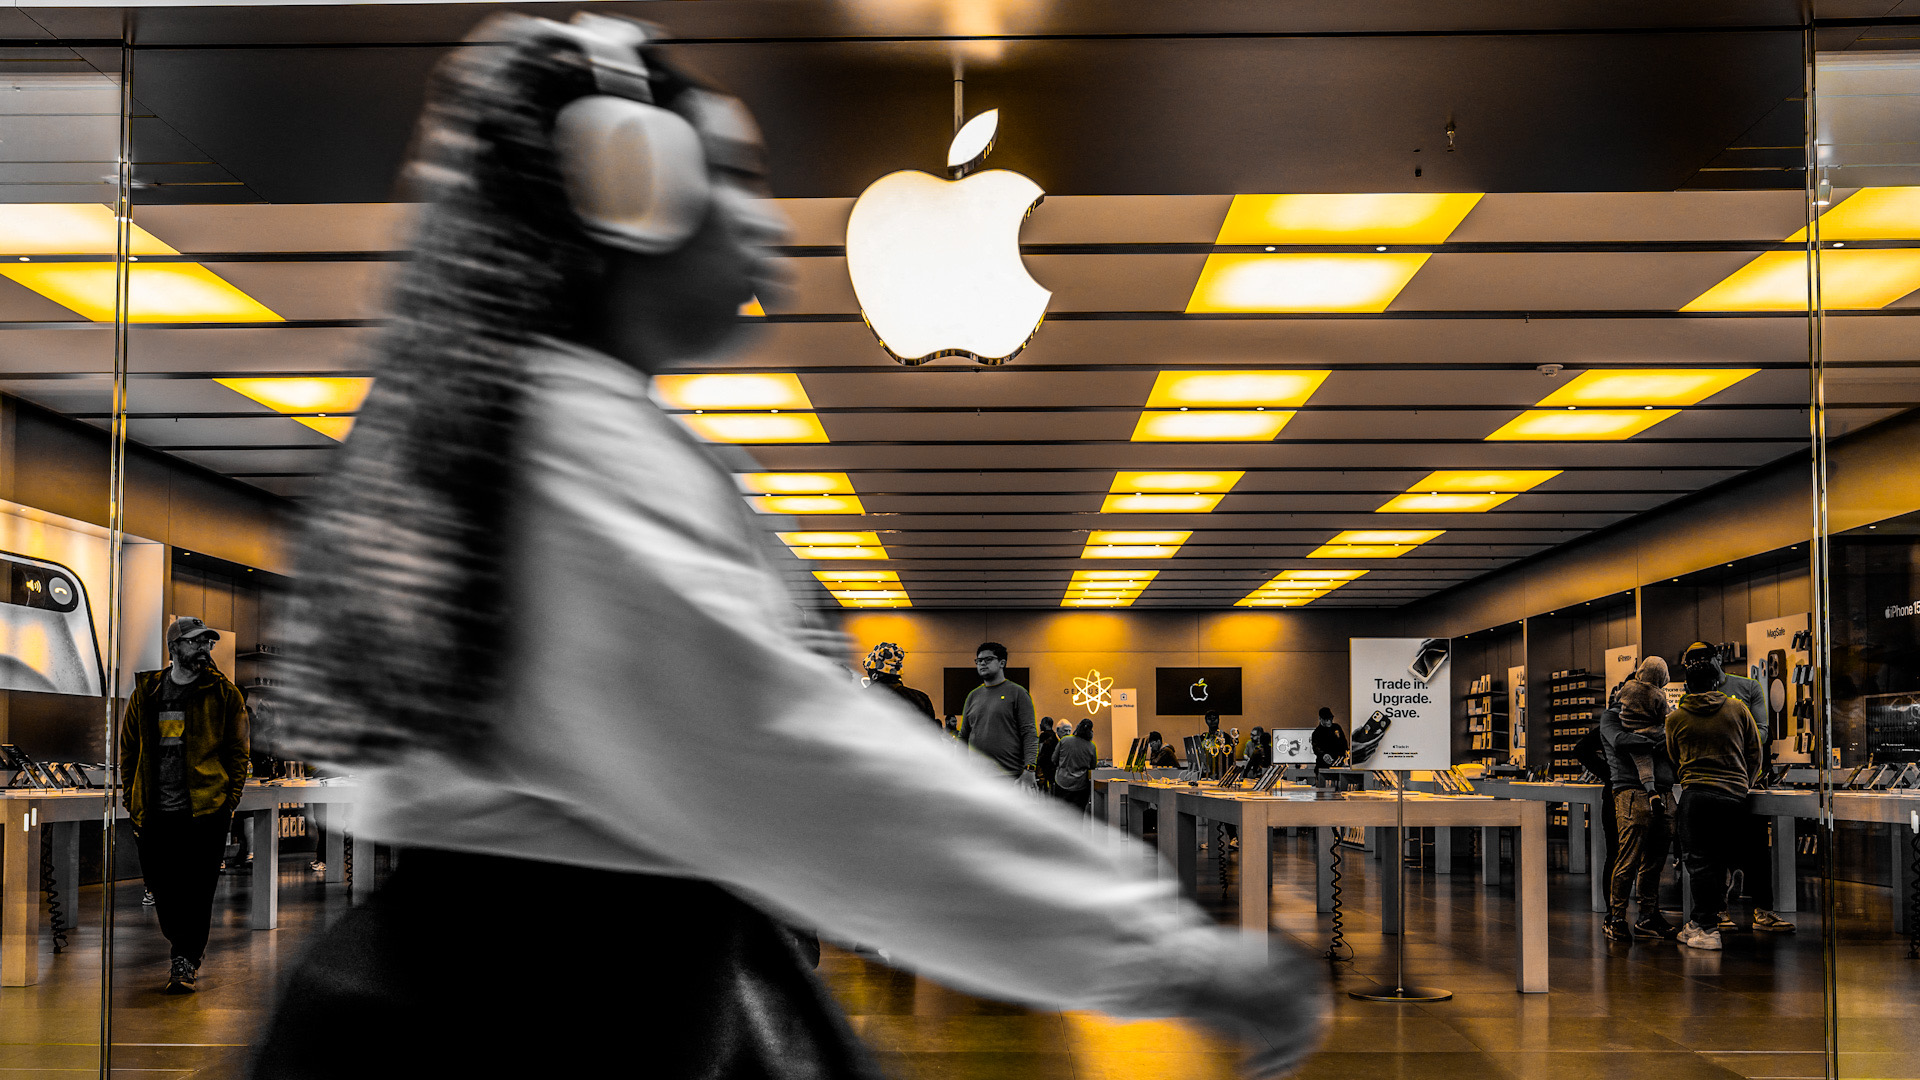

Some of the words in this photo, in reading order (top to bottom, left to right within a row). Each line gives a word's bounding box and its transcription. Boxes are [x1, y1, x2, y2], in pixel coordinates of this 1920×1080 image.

[1890, 605, 1913, 618] iPhone
[1767, 627, 1785, 639] MagSafe
[1374, 678, 1411, 690] Trade
[1413, 678, 1429, 690] in.
[1373, 692, 1432, 706] Upgrade.
[1385, 707, 1420, 718] Save.
